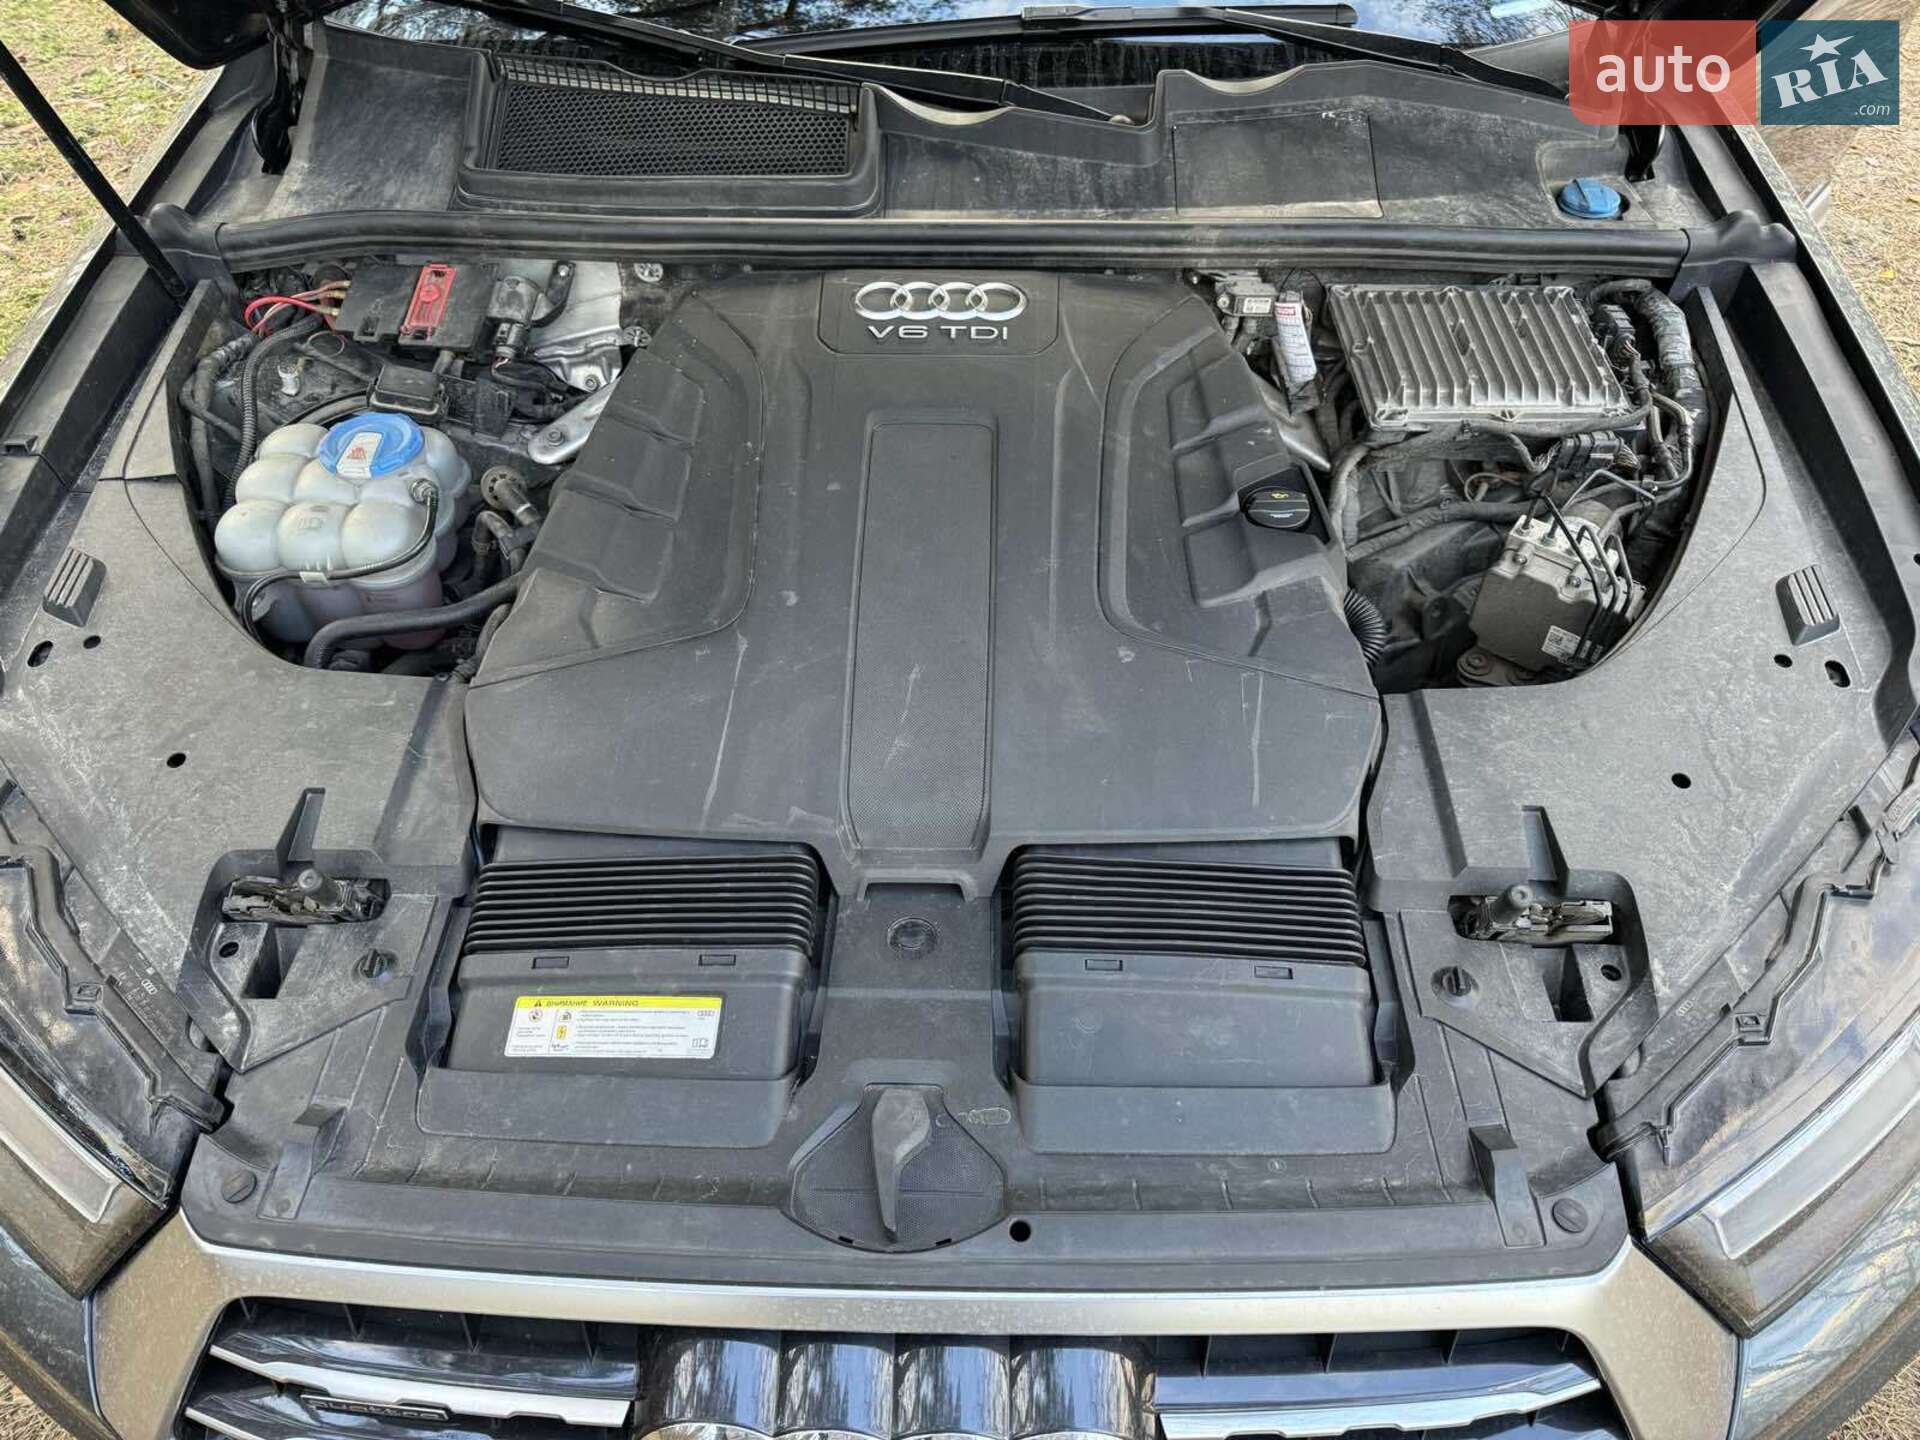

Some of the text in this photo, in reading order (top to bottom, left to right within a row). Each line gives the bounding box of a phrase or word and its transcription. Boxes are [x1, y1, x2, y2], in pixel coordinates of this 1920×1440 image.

[867, 325, 1008, 340] V6 TDI
[592, 999, 640, 1007] WARNING
